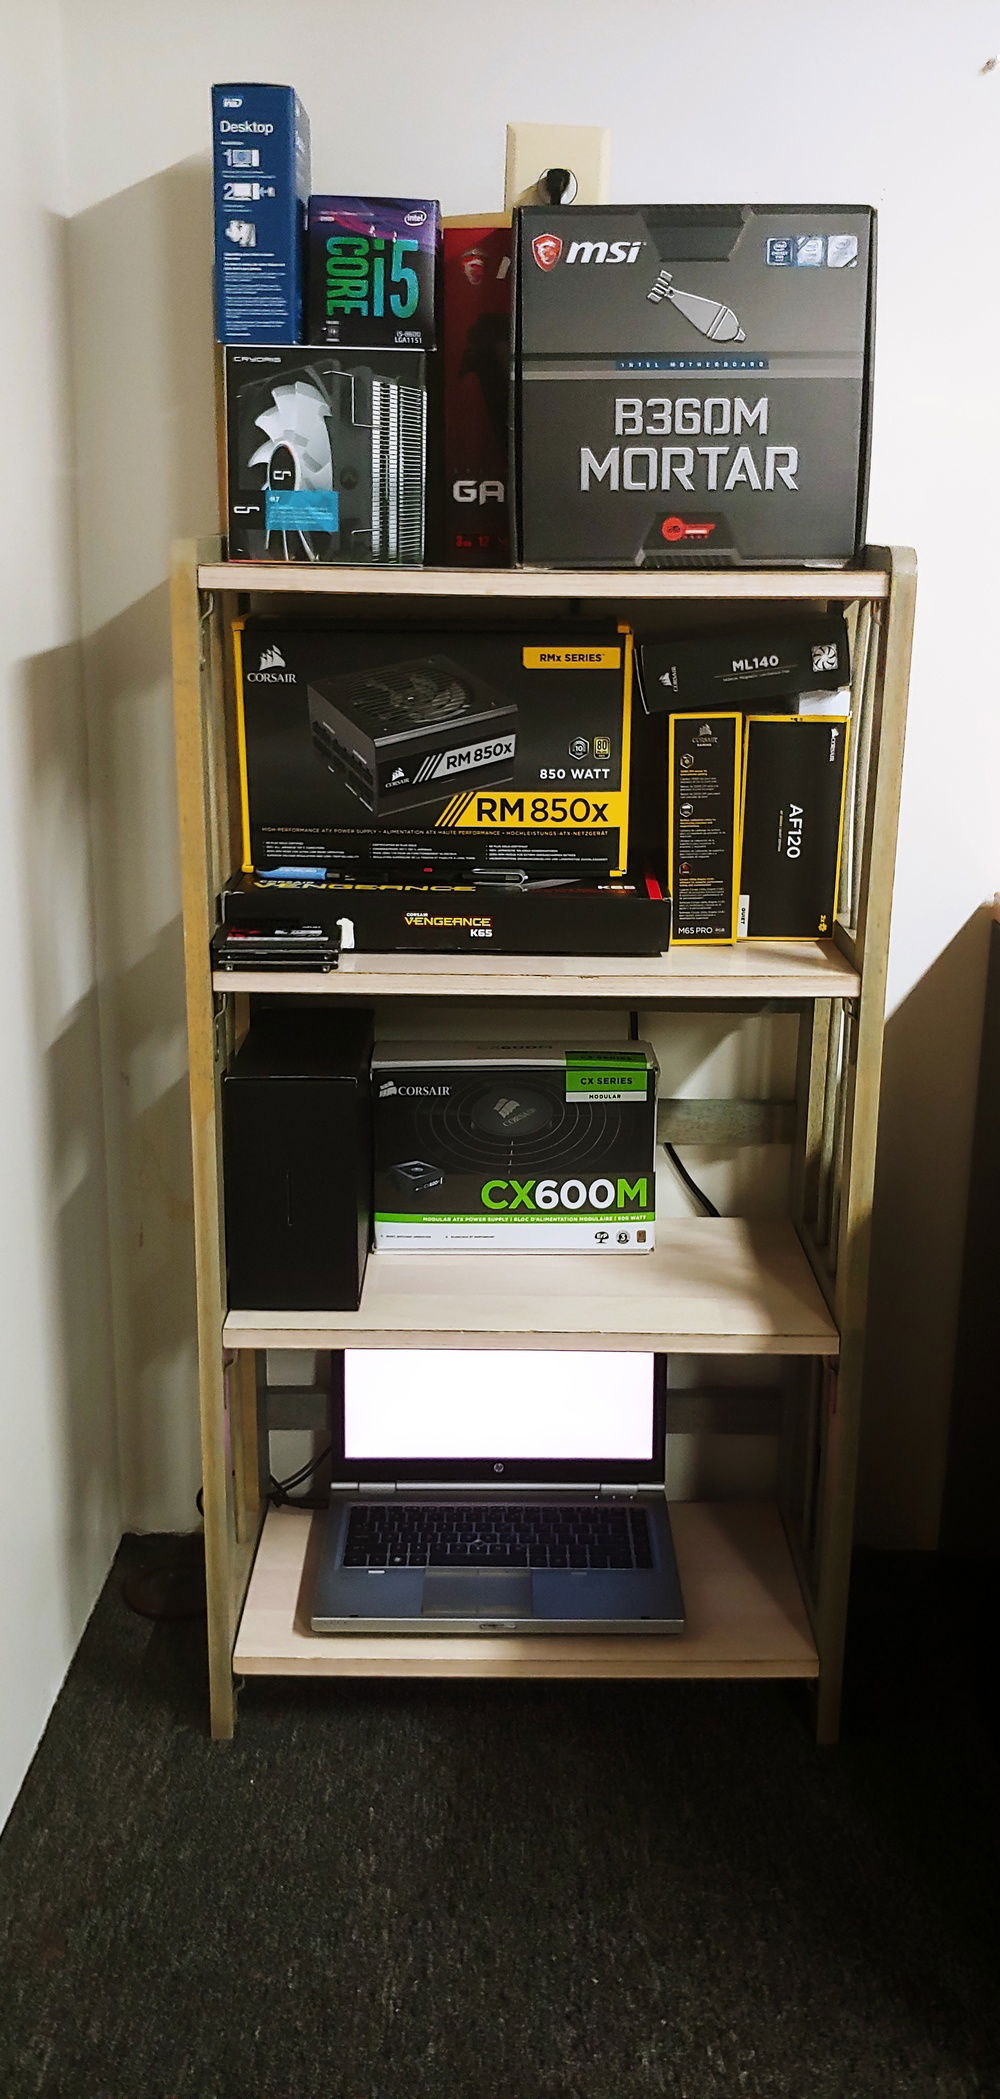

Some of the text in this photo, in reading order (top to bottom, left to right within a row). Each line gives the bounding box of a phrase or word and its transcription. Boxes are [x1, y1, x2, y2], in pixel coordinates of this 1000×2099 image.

[220, 120, 275, 136] Desktop
[566, 240, 644, 265] msi
[326, 237, 369, 317] CORE
[373, 237, 420, 319] i5
[615, 397, 769, 436] B360M
[580, 446, 799, 492] MORTAR
[539, 654, 603, 662] RMx SERIES
[731, 655, 780, 672] ML140
[247, 672, 297, 683] CORSAIR
[596, 740, 608, 751] 80
[828, 738, 837, 763] CORSAIR
[446, 742, 513, 770] RM 850x
[539, 768, 611, 780] 850 WATT
[476, 797, 609, 823] RM 850x
[786, 803, 804, 859] AF120
[253, 881, 478, 892] VENGEANCE
[404, 916, 492, 927] VENGEANCE
[470, 928, 493, 938] K65
[678, 926, 695, 934] M65
[695, 926, 713, 934] PRO
[580, 1077, 633, 1085] CX SERIES
[398, 1086, 451, 1096] CORSAIR
[480, 1177, 648, 1210] CX600M
